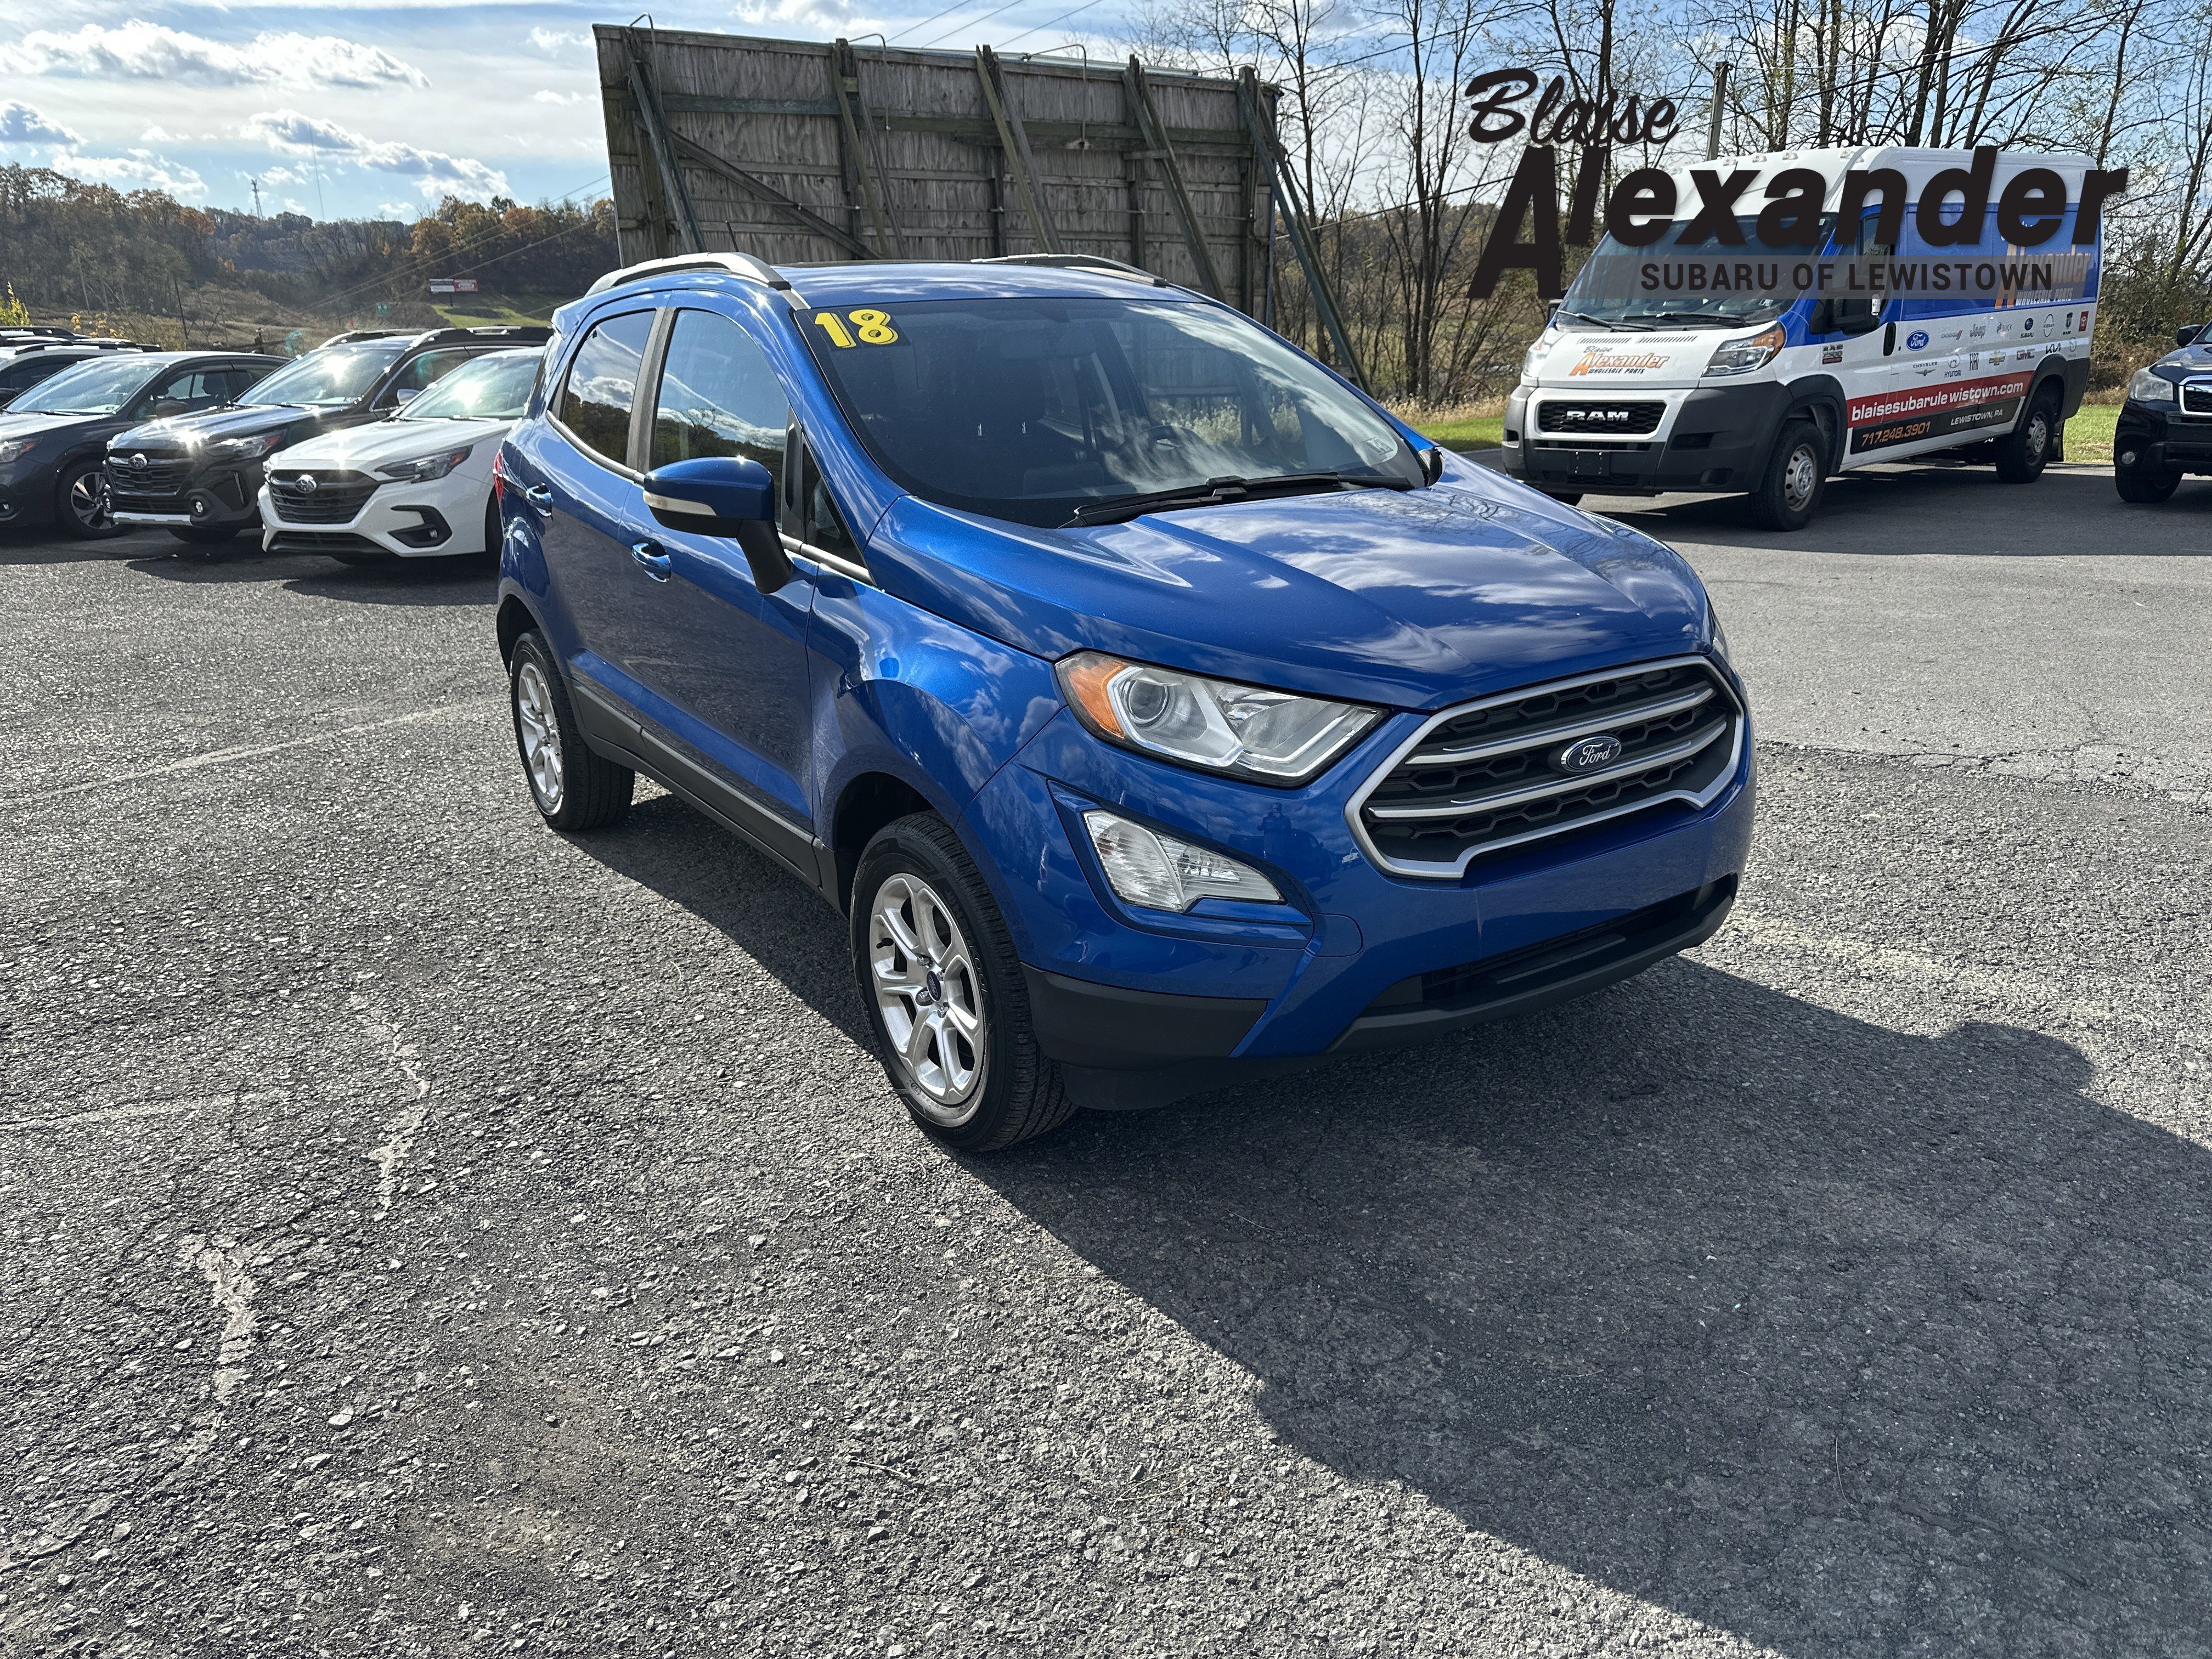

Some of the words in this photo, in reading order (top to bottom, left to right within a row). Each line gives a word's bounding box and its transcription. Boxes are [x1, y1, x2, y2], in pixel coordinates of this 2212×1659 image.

[815, 309, 898, 348] 18
[1970, 324, 1986, 338] Jeep
[1569, 352, 1671, 376] Alexander
[2016, 348, 2035, 360] GMC
[1566, 410, 1629, 421] RAM
[1950, 411, 1994, 426] LEWISTOWN,
[1994, 409, 2004, 420] PA
[1861, 421, 1932, 447] 717.248.3901
[1579, 743, 1617, 766] Ford
